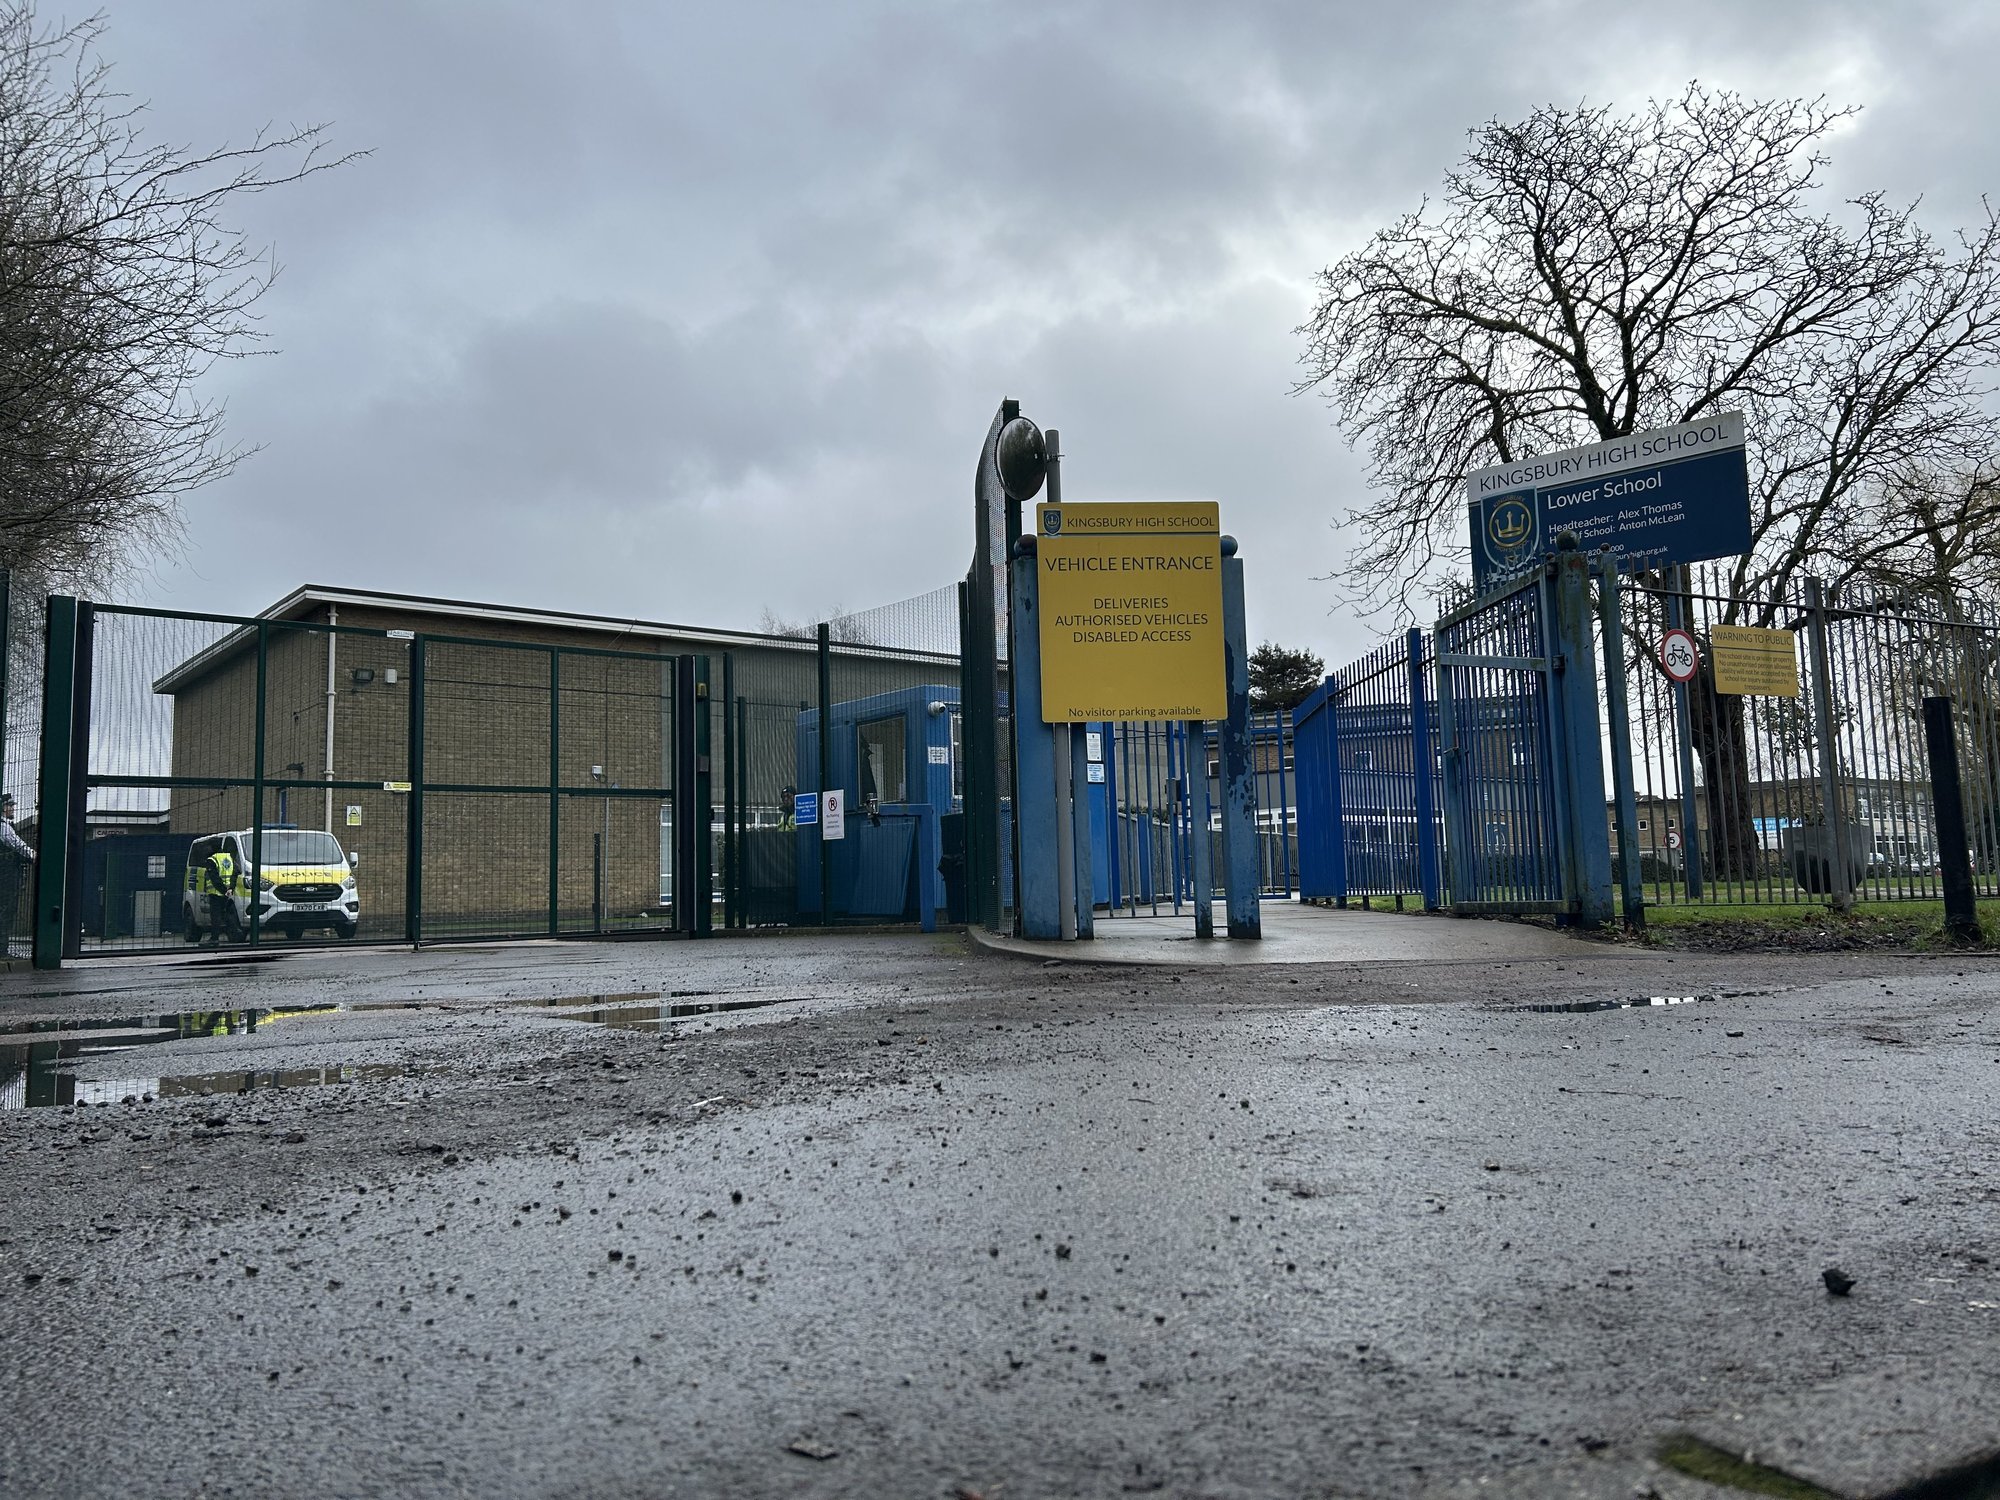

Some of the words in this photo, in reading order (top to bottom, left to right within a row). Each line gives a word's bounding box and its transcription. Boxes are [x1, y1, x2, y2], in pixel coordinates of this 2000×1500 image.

[1480, 455, 1583, 492] KINGSBURY
[1588, 443, 1638, 469] HIGH
[1642, 424, 1729, 457] SCHOOL
[1547, 488, 1600, 509] Lower
[1603, 471, 1662, 499] School
[1067, 517, 1133, 528] KINGSBURY
[1135, 517, 1165, 527] HIGH
[1167, 516, 1215, 527] SCHOOL
[1549, 514, 1614, 534] Headteacher:
[1618, 509, 1640, 520] Alex
[1641, 501, 1683, 516] Thomas
[1584, 525, 1616, 538] School:
[1619, 519, 1647, 532] Anton
[1648, 513, 1685, 526] McLean
[1046, 557, 1117, 572] VEHICLE
[1122, 556, 1214, 571] ENTRANCE
[1094, 597, 1169, 609] DELIVERIES
[1055, 615, 1142, 627] AUTHORISED
[1145, 613, 1209, 626] VEHICLES
[1073, 631, 1138, 643] DISABLED
[1141, 630, 1192, 642] ACCESS
[1714, 631, 1753, 642] WARNING
[1754, 635, 1764, 643] TO
[1765, 636, 1792, 646] PUBLIC
[1068, 708, 1083, 717] No
[1085, 706, 1116, 717] visitor
[1119, 706, 1156, 718] parking
[1158, 705, 1201, 716] available
